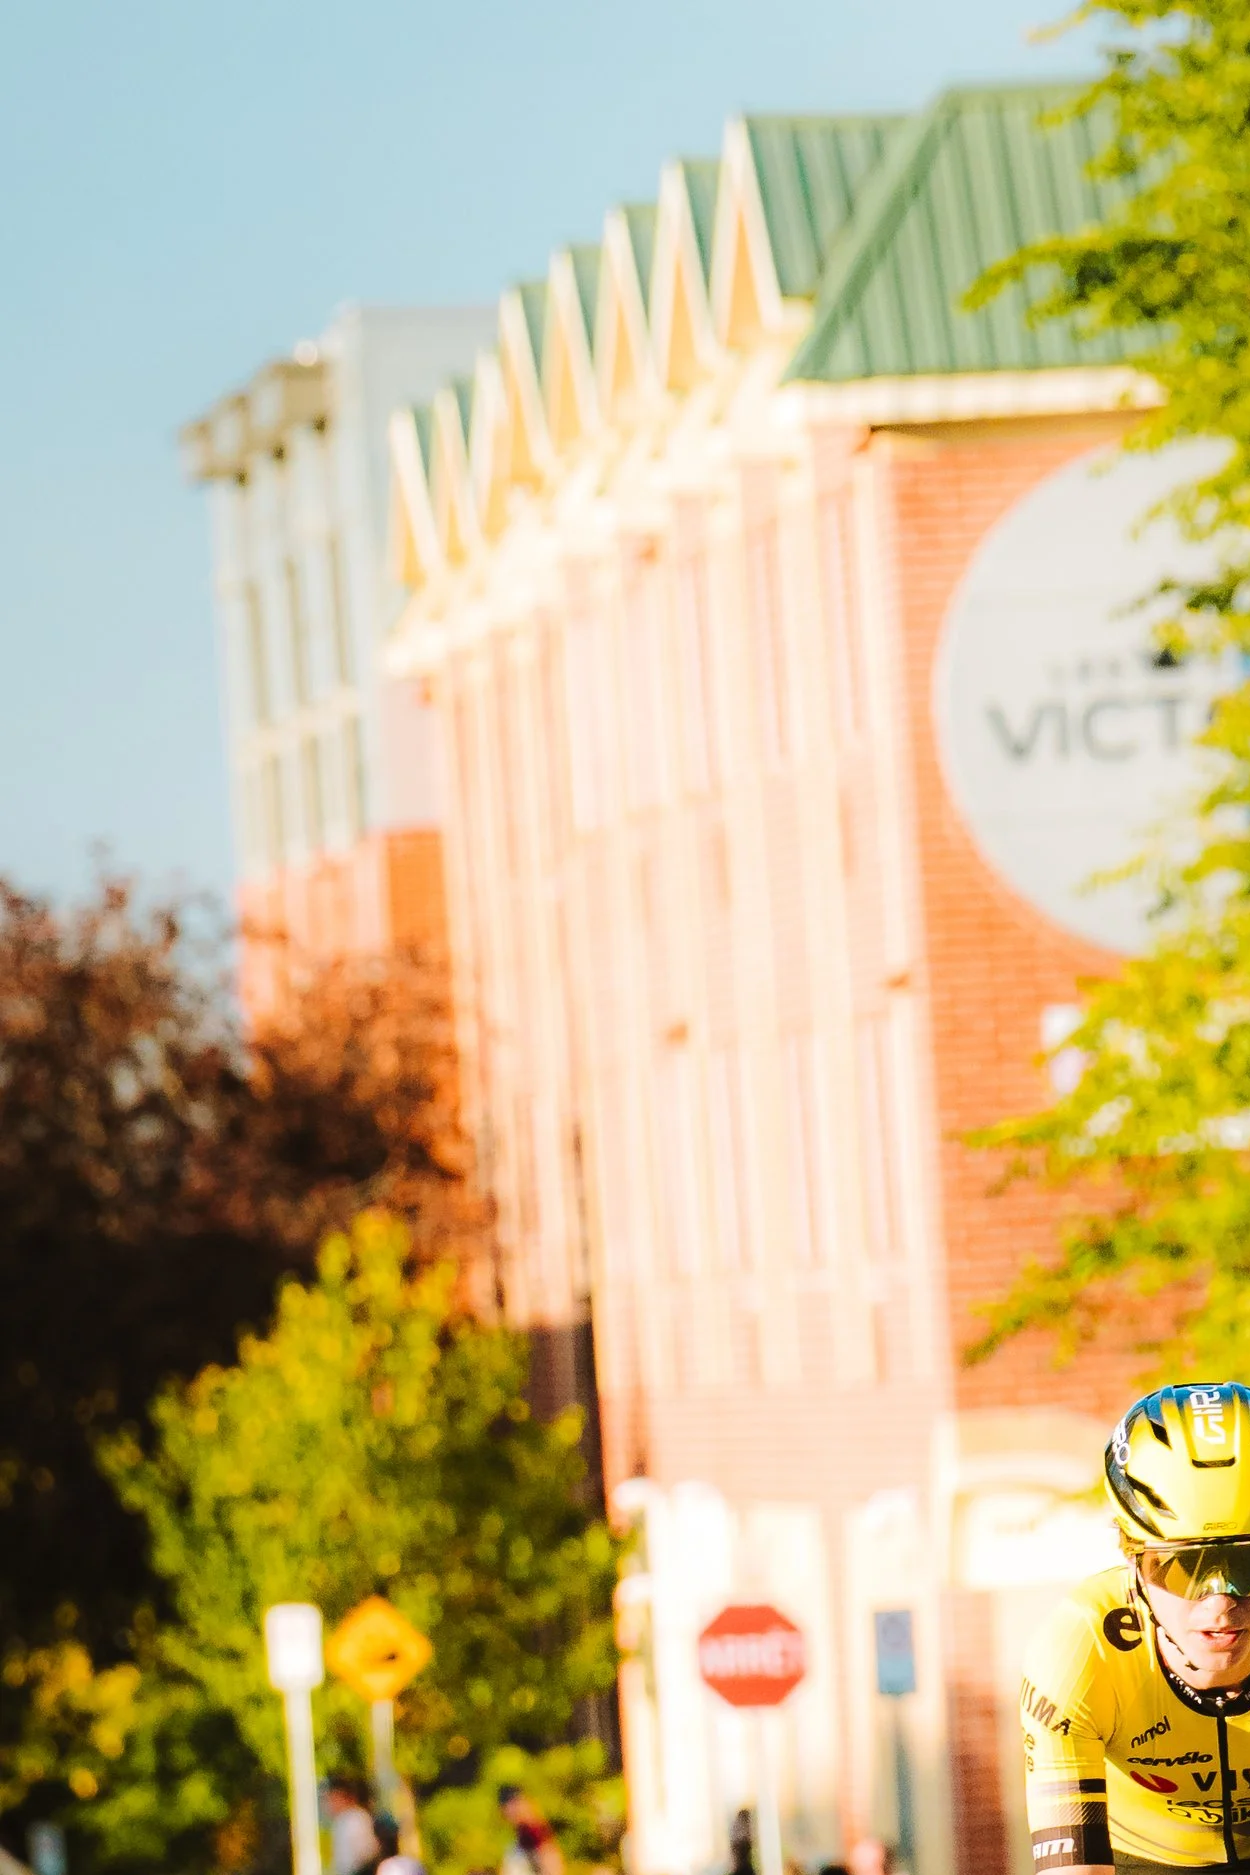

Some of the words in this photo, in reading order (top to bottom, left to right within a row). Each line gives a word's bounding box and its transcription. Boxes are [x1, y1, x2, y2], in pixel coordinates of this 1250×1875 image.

[986, 692, 1216, 764] VICT
[1203, 1521, 1238, 1531] GIRO
[1021, 1678, 1071, 1736] ISMA
